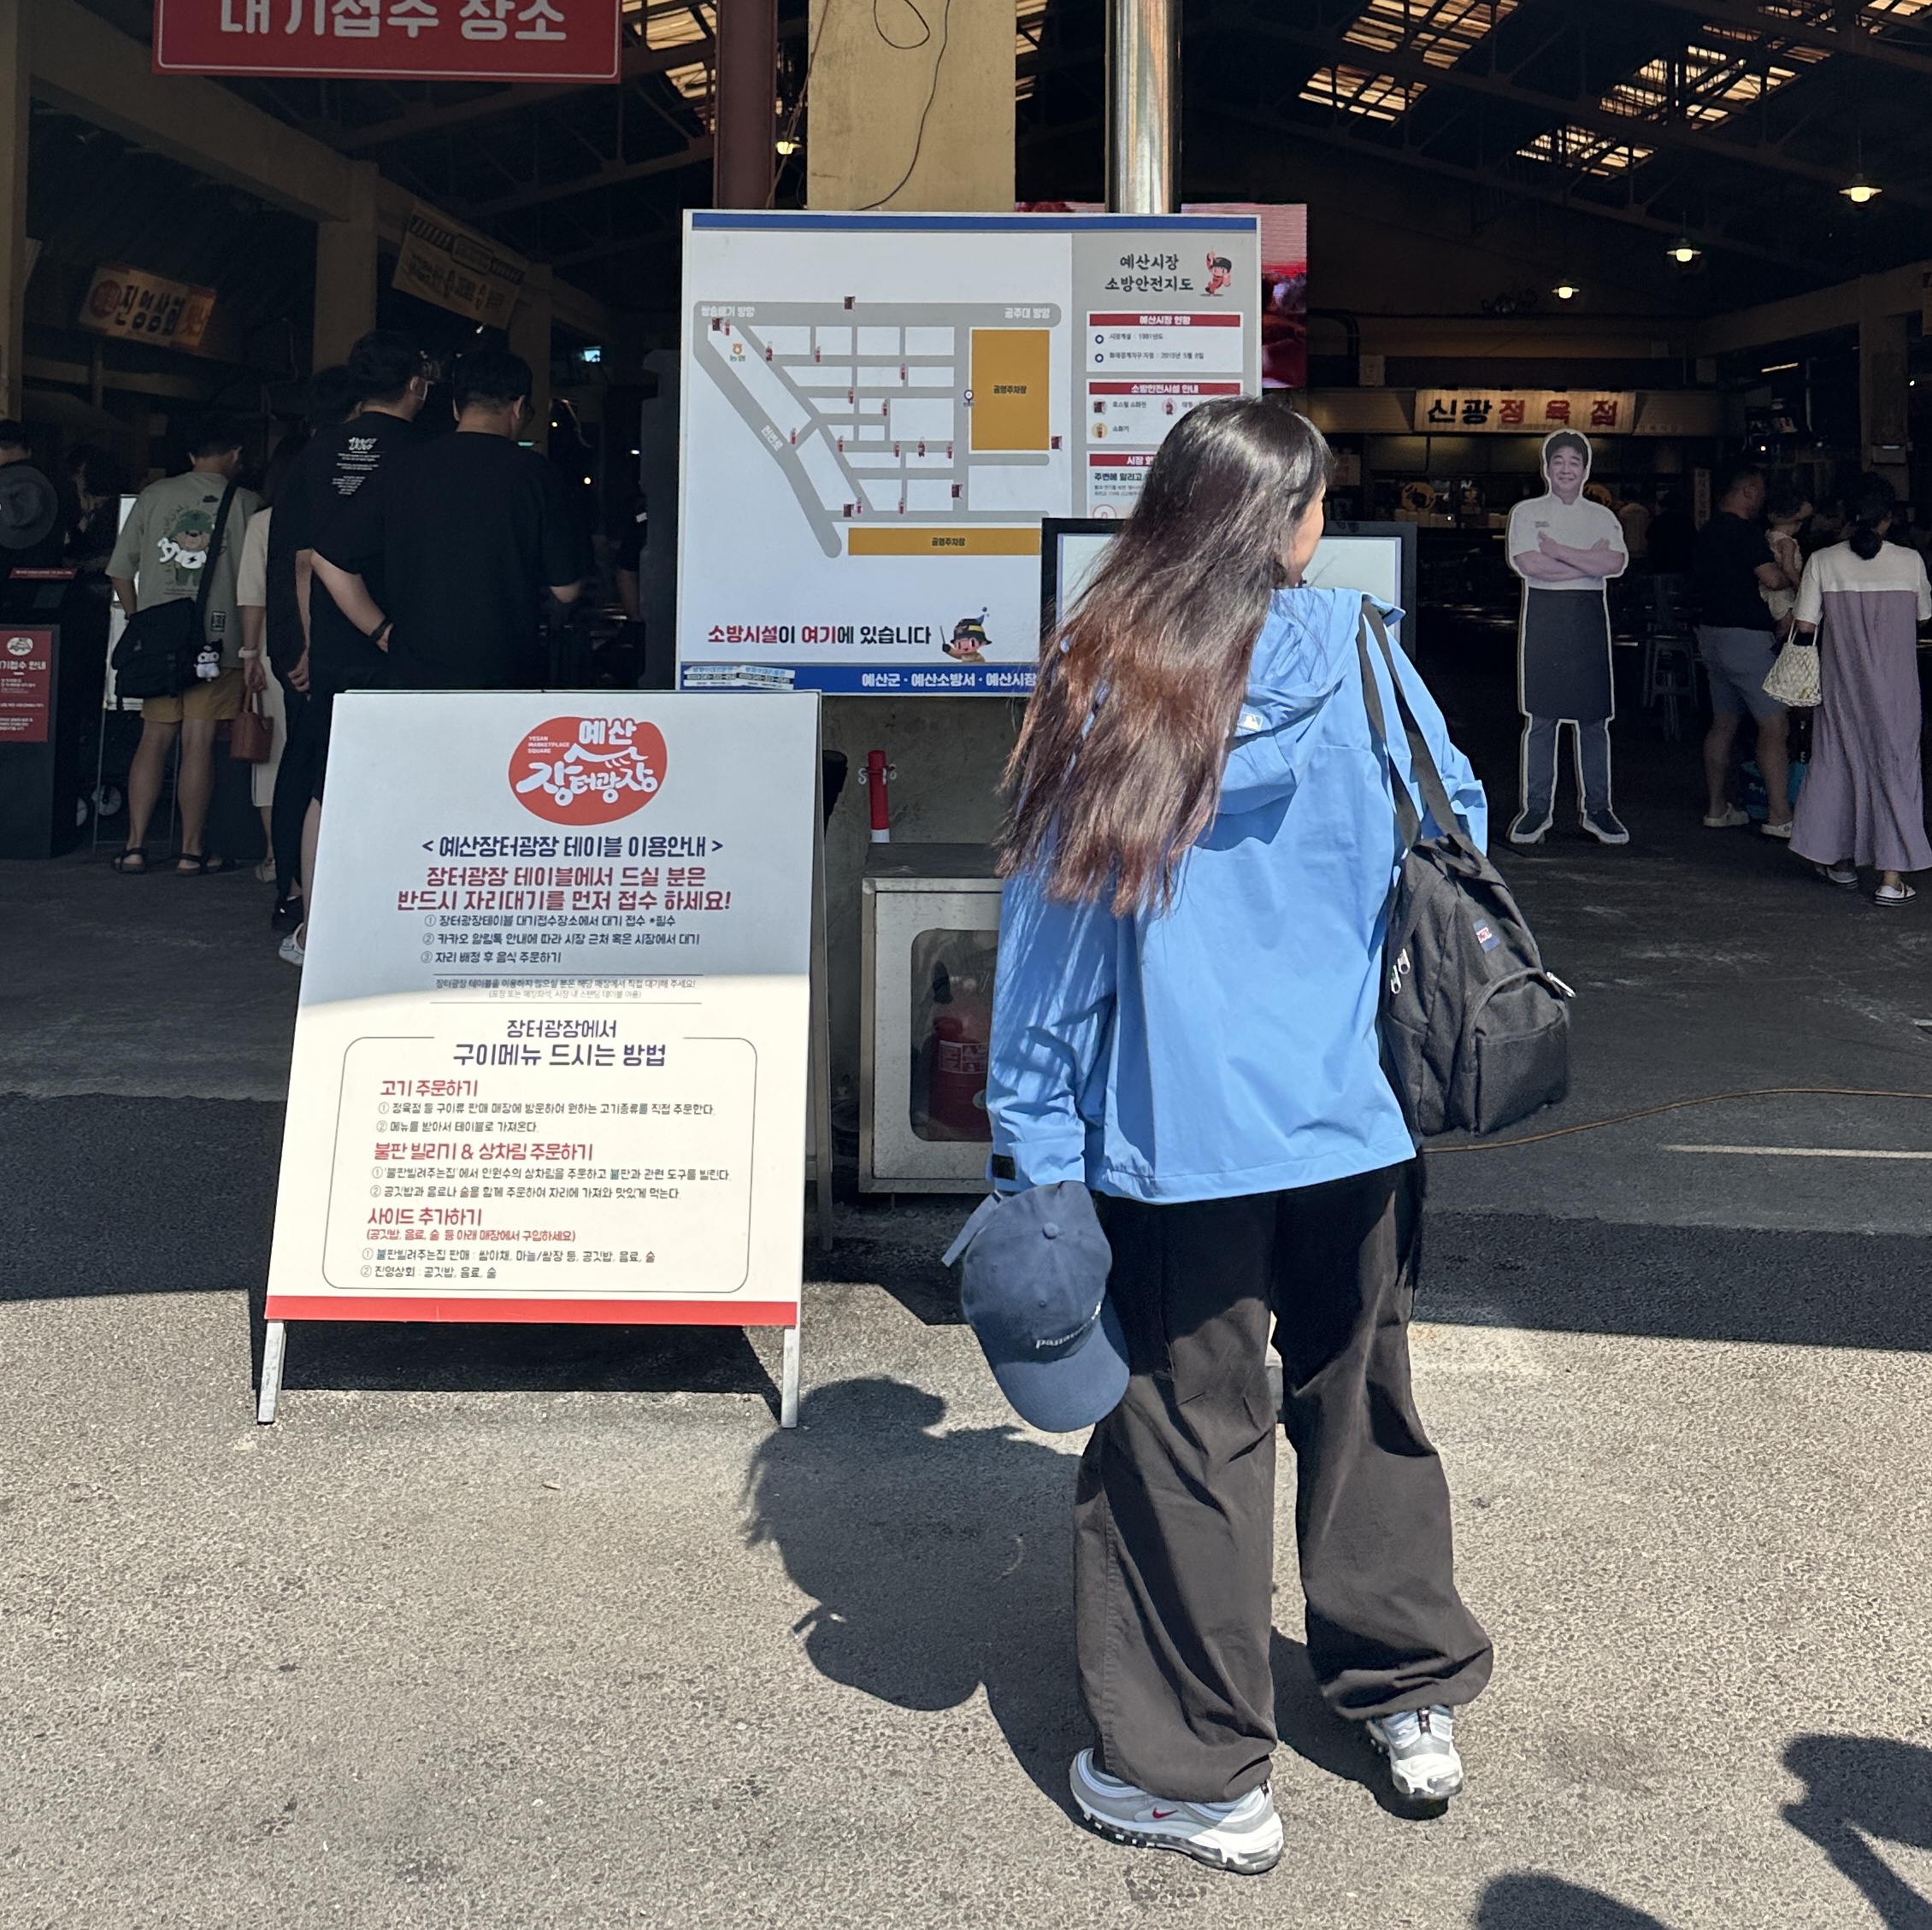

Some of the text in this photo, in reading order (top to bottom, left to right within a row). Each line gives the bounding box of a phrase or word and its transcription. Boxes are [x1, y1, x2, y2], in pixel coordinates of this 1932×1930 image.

[460, 0, 566, 40] 장소
[1119, 253, 1179, 271] 예산시장
[1104, 274, 1193, 291] 소방안전지도
[1139, 315, 1173, 326] 예산시장
[1130, 384, 1199, 394] 소방안전시설 안내
[1428, 399, 1493, 424] 신광
[708, 625, 932, 644] 소방시설이 여기에 있습니다
[862, 672, 1037, 687] 예산군 예산소방서 예산시장
[579, 721, 637, 745] 예산
[515, 761, 658, 807] 장터광장
[439, 836, 705, 857] 예산장터광장 테이블 이용안내
[427, 867, 706, 886] 장터광장 테이블에서 드실 분은
[398, 891, 731, 910] 반드시 자리대기를 먼저 접수 하세요!
[439, 915, 514, 927] 장터광장테이블
[516, 915, 598, 927] 대기접수장소에서
[602, 915, 622, 927] 대기
[626, 915, 645, 927] 접수
[438, 933, 468, 944] 카카오
[506, 933, 538, 944] 안내에
[541, 933, 562, 944] 따라
[564, 933, 586, 944] 시장
[589, 933, 609, 944] 근처
[612, 933, 632, 944] 혹은
[634, 933, 676, 944] 시장에서
[679, 933, 699, 945] 대기
[435, 952, 456, 962] 자리
[459, 951, 480, 963] 배정
[483, 951, 493, 962] 후
[497, 951, 516, 963] 음식
[519, 951, 561, 963] 주문하기
[507, 1020, 616, 1038] 장터광장에서
[453, 1044, 665, 1066] 구이메뉴 드시는 방법
[380, 1080, 478, 1097] 고기 주문하기
[392, 1103, 421, 1114] 정육점
[424, 1103, 433, 1114] 등
[437, 1103, 464, 1114] 구이류
[468, 1103, 488, 1114] 판매
[492, 1103, 521, 1114] 매장에
[525, 1103, 564, 1114] 방문하여
[568, 1103, 597, 1114] 원하는
[600, 1103, 648, 1115] 고기종류를
[651, 1103, 670, 1115] 직접
[391, 1121, 419, 1132] 메뉴를
[422, 1121, 451, 1132] 받아서
[455, 1121, 493, 1132] 테이블로
[374, 1143, 408, 1161] 불판
[411, 1143, 456, 1161] 빌리기
[479, 1143, 527, 1161] 상차림
[530, 1143, 593, 1161] 주문하기
[368, 1207, 481, 1227] 사이드 추가하기
